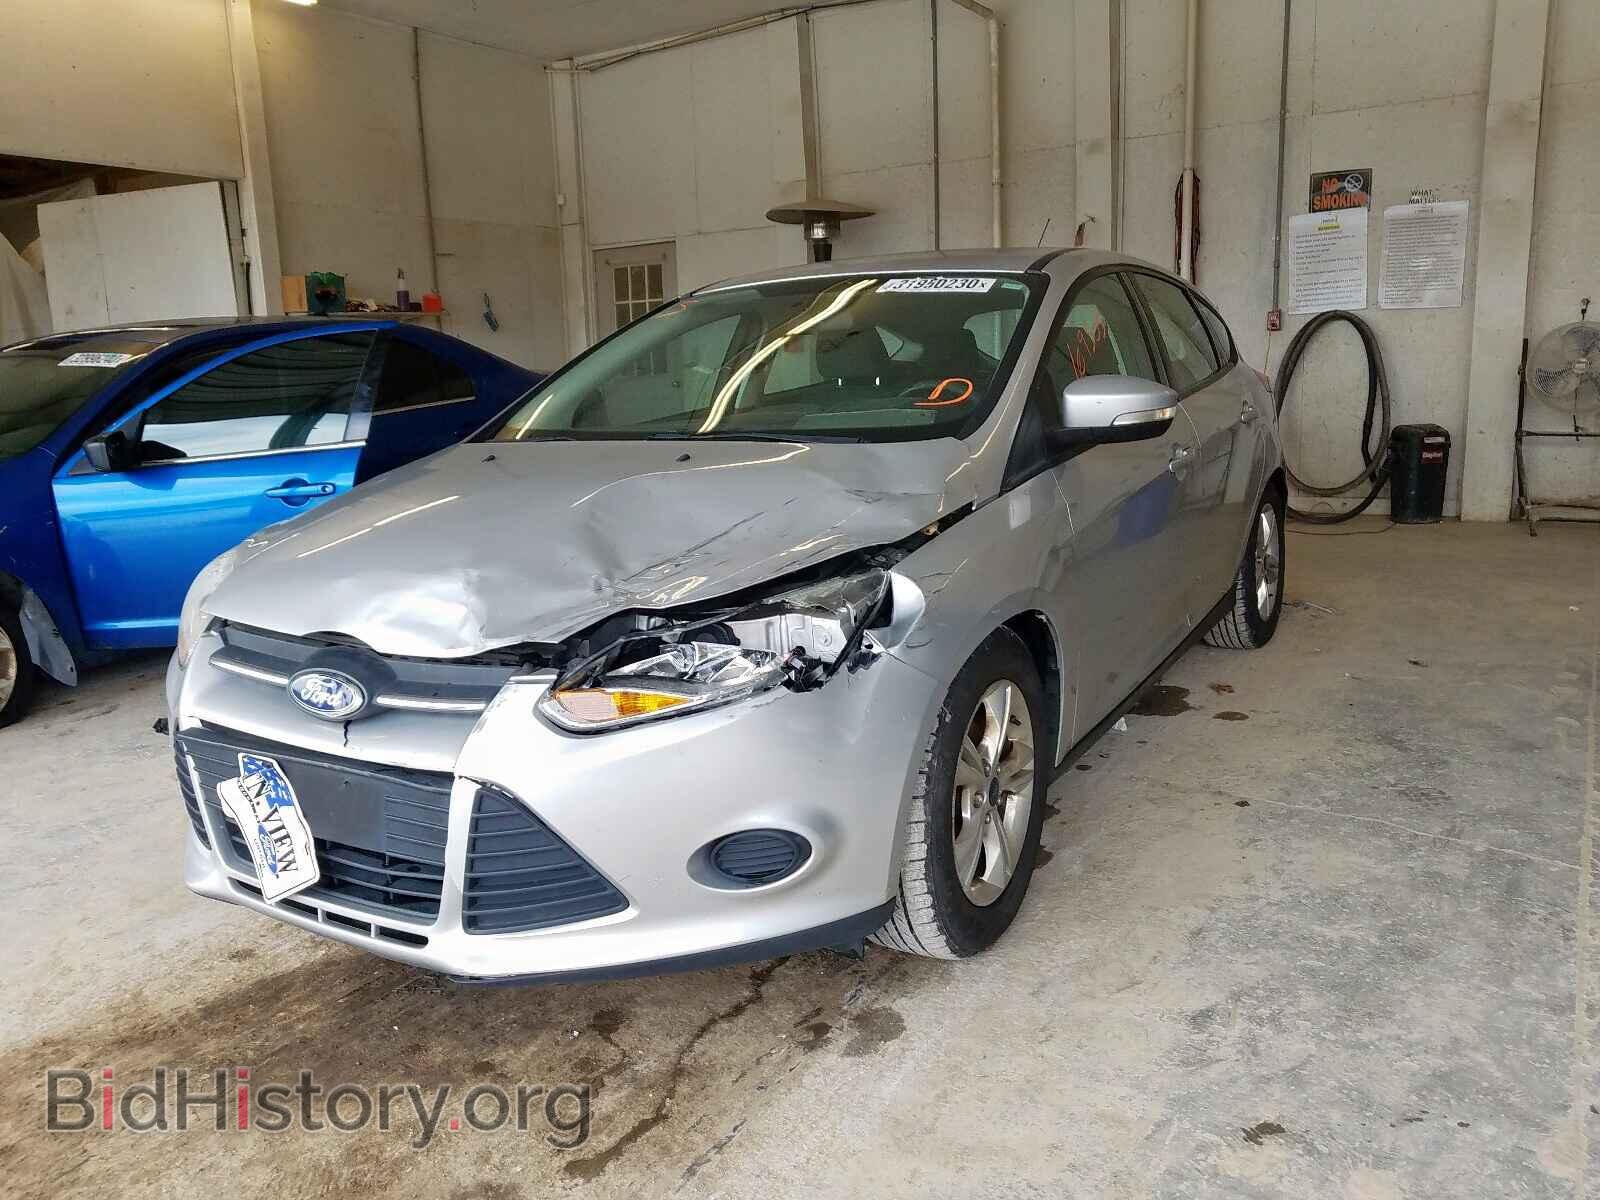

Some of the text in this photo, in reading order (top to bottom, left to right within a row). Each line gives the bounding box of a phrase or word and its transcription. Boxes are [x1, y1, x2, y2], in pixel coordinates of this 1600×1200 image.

[1322, 178, 1338, 192] NO
[301, 679, 350, 707] Ford
[261, 806, 299, 873] VIEW
